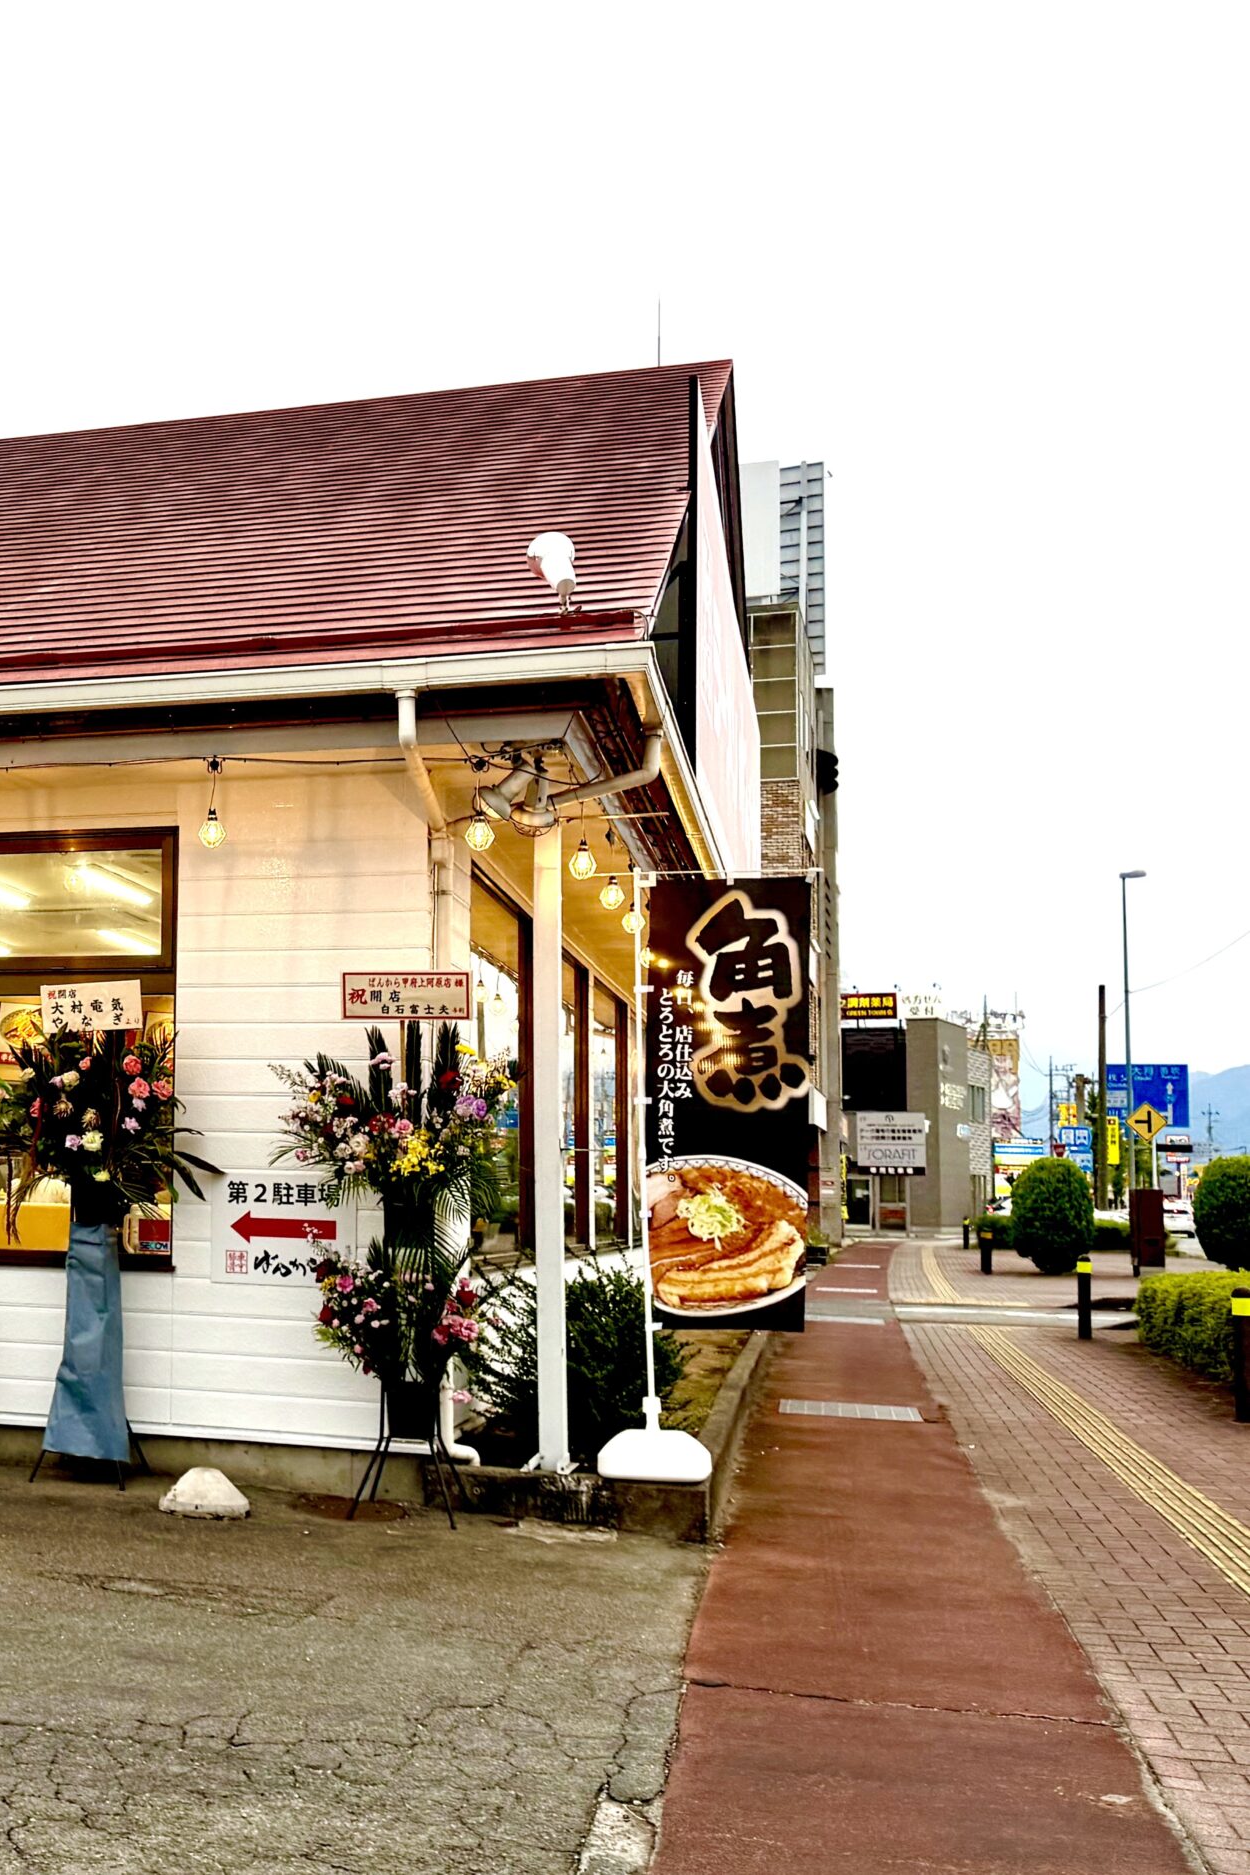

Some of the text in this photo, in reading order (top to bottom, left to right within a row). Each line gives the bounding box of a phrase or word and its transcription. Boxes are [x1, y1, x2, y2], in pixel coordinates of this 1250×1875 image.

[348, 988, 401, 1005] 祝 開店
[674, 969, 694, 1100] 毎日、店仕込み
[690, 893, 809, 1108] 角煮
[657, 987, 677, 1183] とろとろの大角煮です。
[227, 1180, 343, 1208] 第2駐車場
